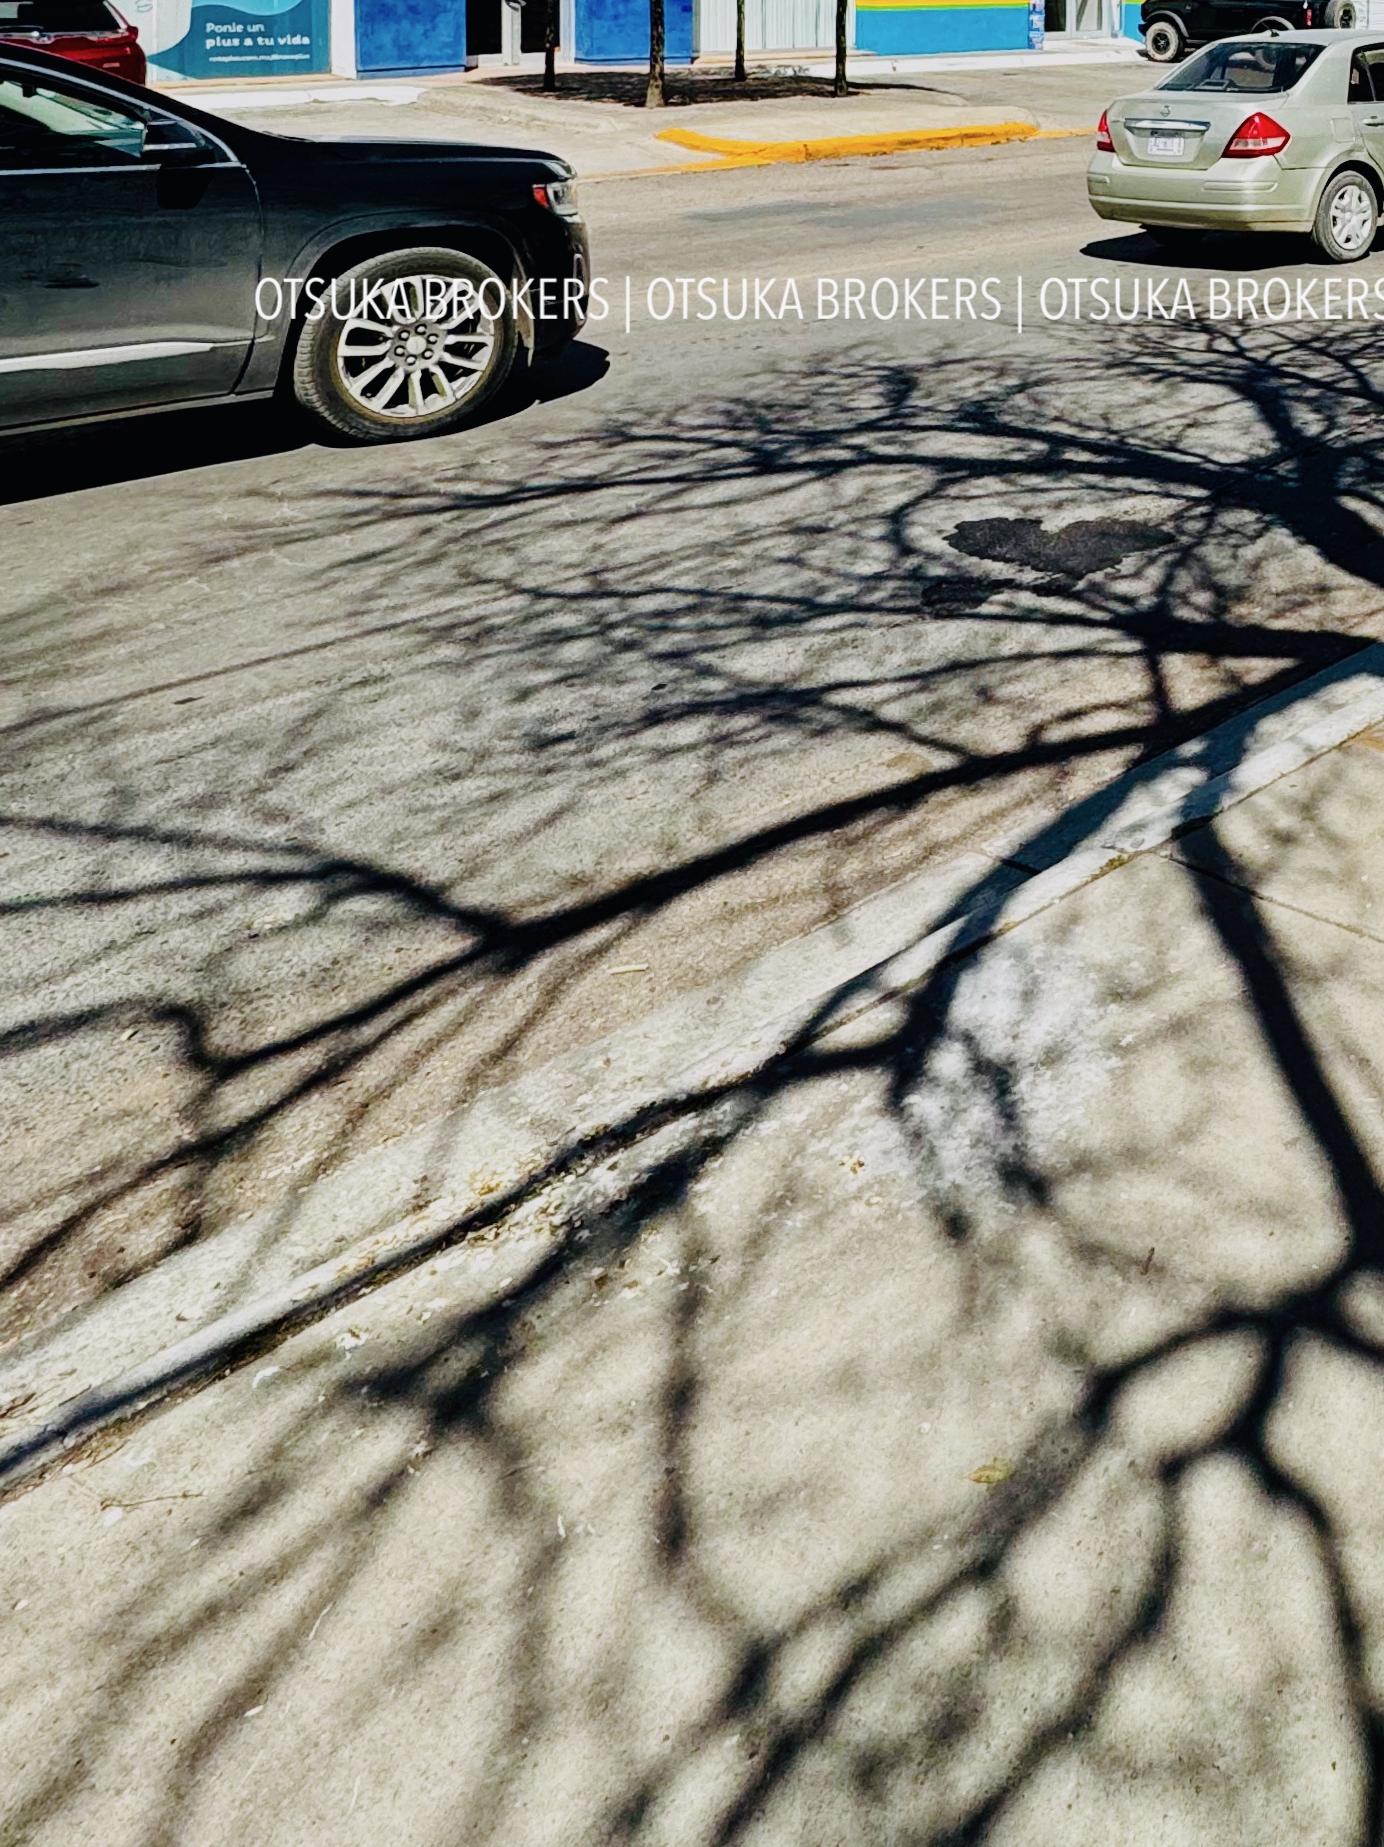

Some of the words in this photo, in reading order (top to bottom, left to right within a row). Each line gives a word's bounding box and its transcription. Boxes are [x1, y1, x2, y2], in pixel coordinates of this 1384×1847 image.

[247, 23, 265, 32] un
[243, 37, 254, 46] a
[257, 36, 275, 46] tu
[277, 34, 311, 45] vida
